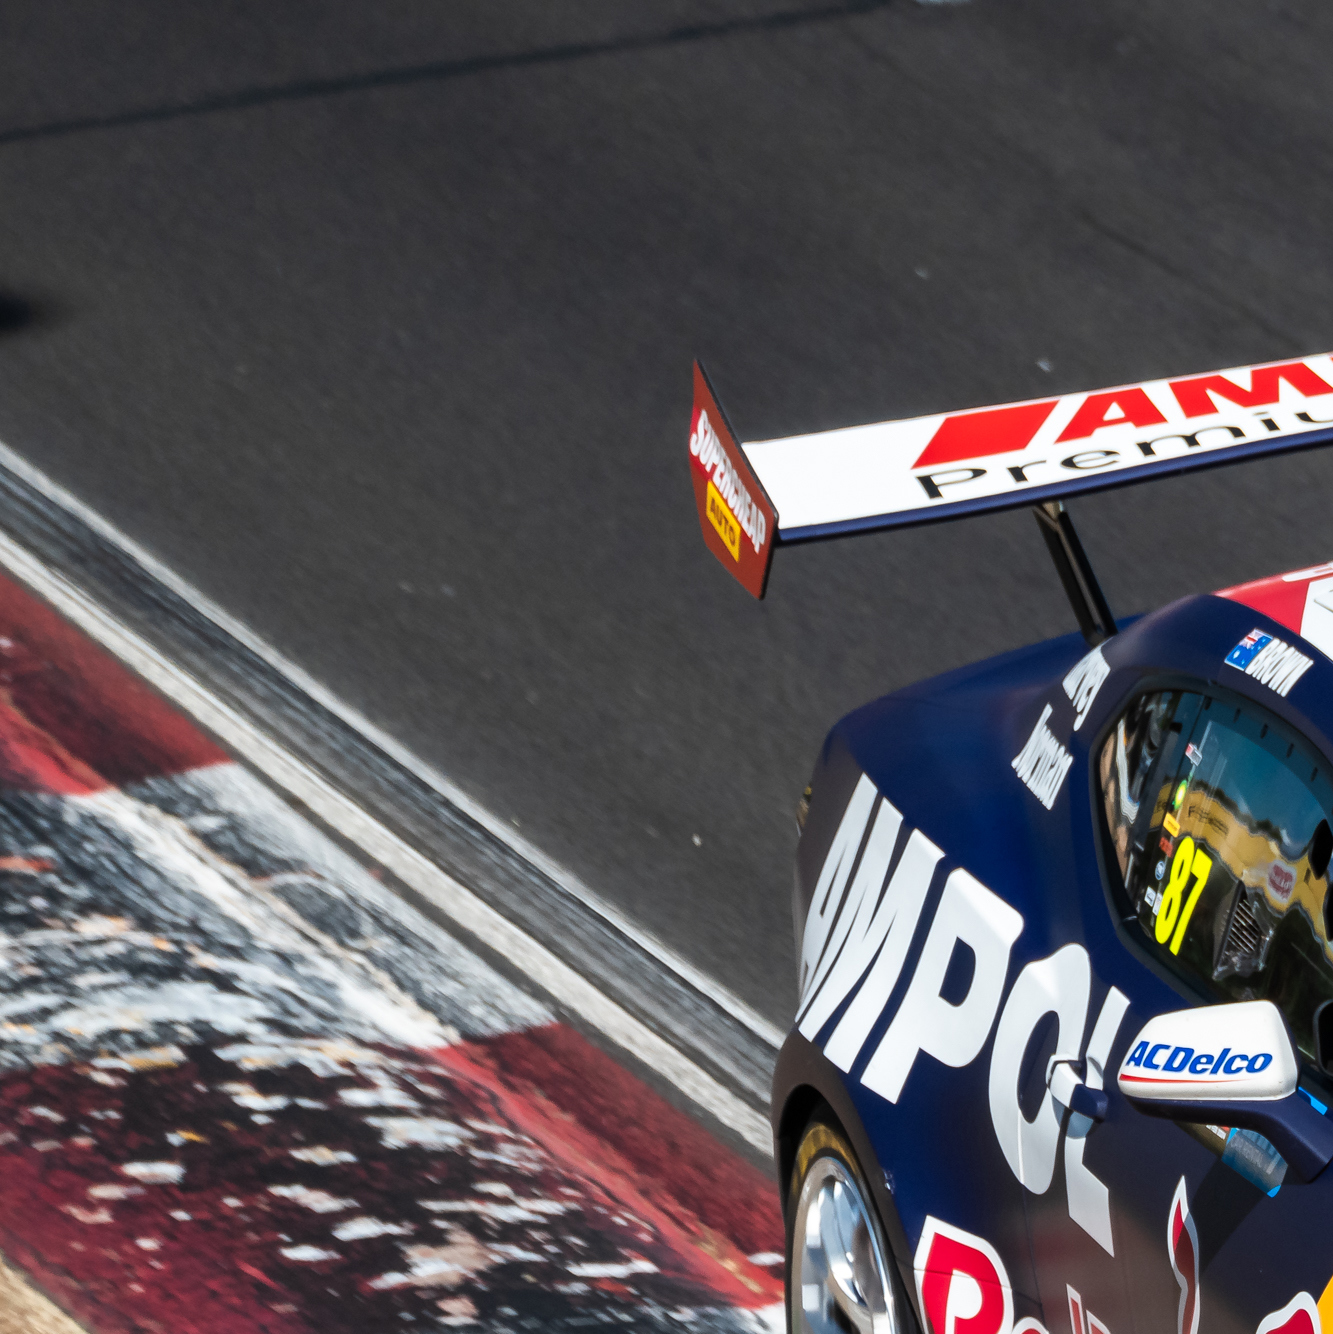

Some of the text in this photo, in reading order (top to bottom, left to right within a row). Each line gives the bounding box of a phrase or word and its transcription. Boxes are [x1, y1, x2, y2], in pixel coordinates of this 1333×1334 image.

[690, 408, 766, 554] SUPERCHEAP
[709, 497, 736, 548] AUTO
[1245, 637, 1315, 697] BROWN
[1154, 836, 1212, 956] 87
[795, 771, 1131, 1257] AMPOL
[1126, 1041, 1273, 1075] ACDelco
